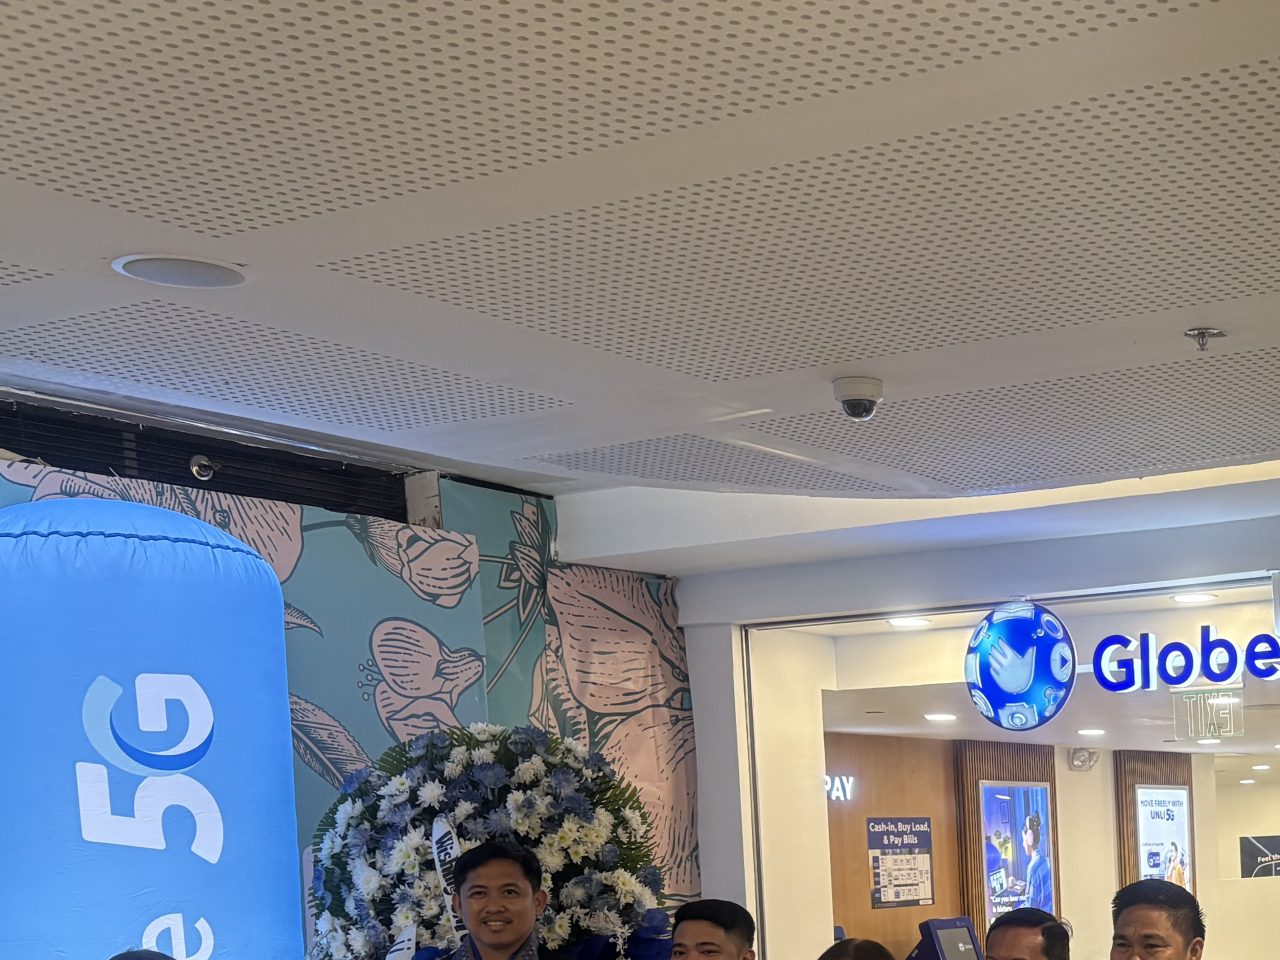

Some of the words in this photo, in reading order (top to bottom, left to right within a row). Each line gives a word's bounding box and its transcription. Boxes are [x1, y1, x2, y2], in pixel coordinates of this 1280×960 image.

[75, 673, 224, 864] 5G
[869, 822, 897, 832] Cash-in,
[898, 822, 911, 833] Buy
[912, 822, 930, 832] Load,
[883, 835, 889, 844] &
[889, 835, 902, 846] Pay
[903, 835, 918, 844] Bills
[1257, 854, 1271, 863] Feel
